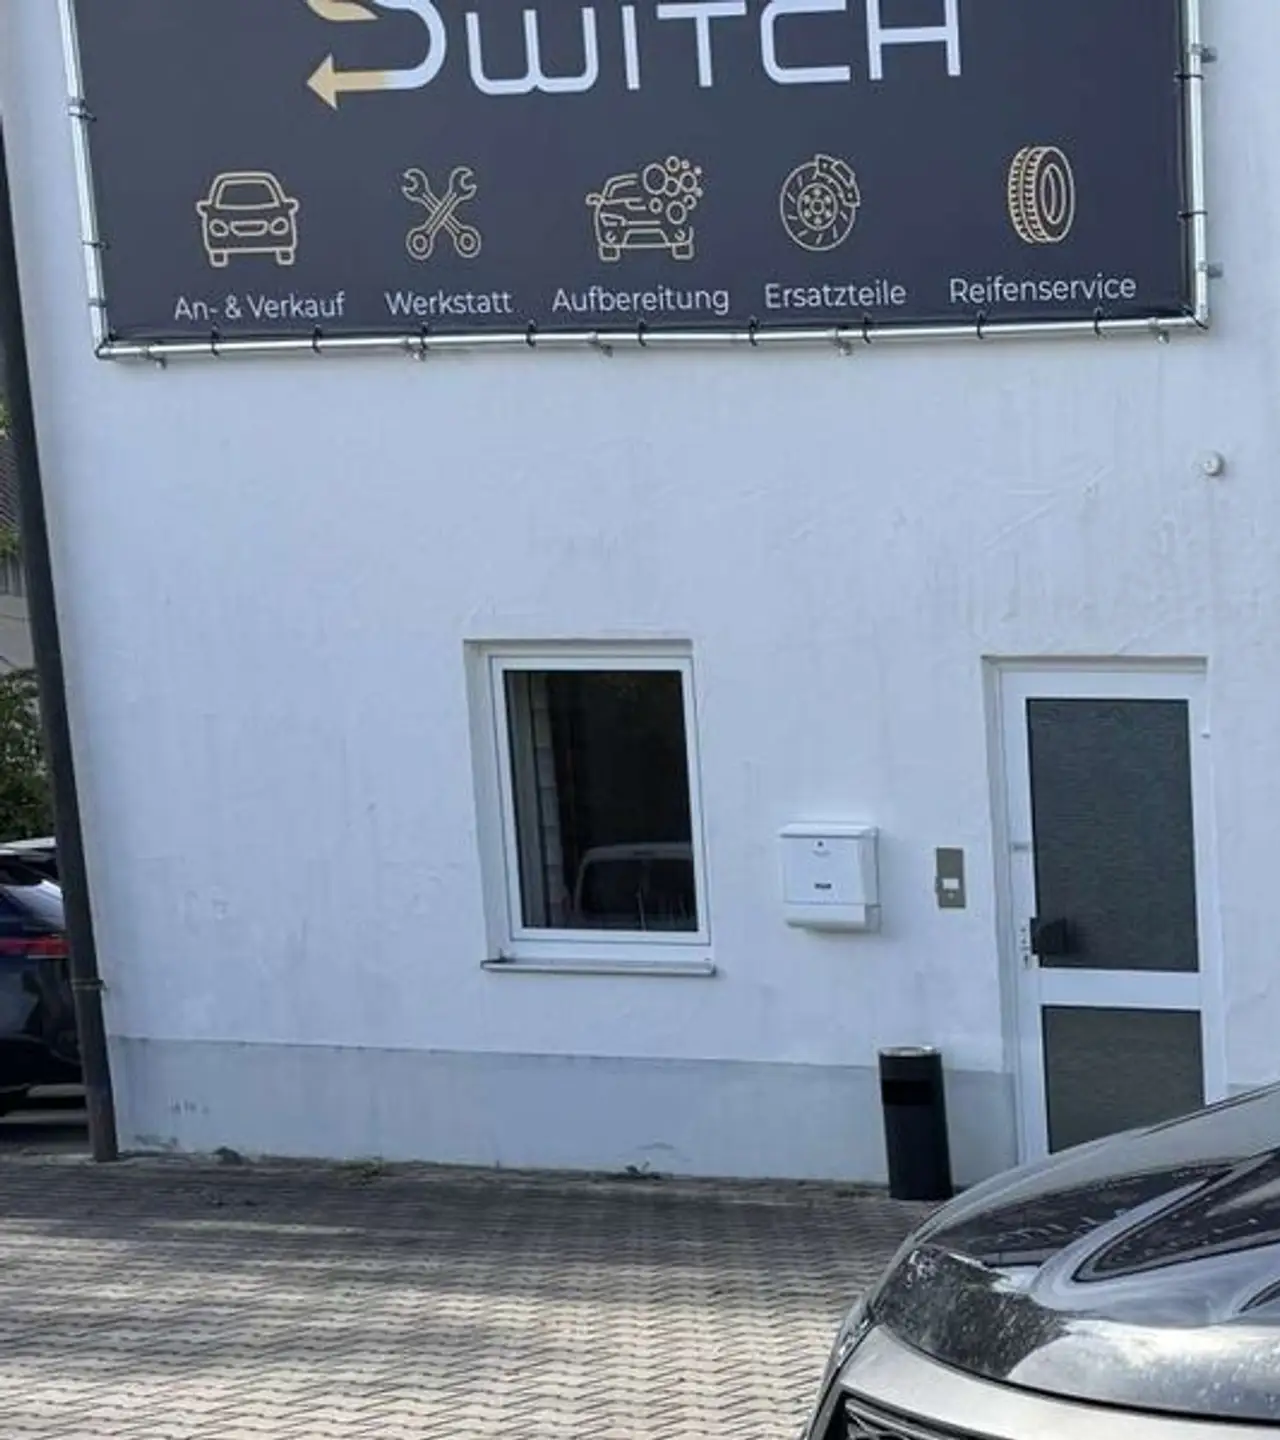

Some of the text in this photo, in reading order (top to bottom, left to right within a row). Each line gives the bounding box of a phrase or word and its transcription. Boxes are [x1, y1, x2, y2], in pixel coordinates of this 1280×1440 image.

[551, 286, 730, 316] Aufbereitung
[764, 280, 907, 309] Ersatzteile
[949, 272, 1137, 304] Reifenservice
[174, 291, 346, 321] An- & Verkauf
[385, 290, 513, 317] Werkstatt
